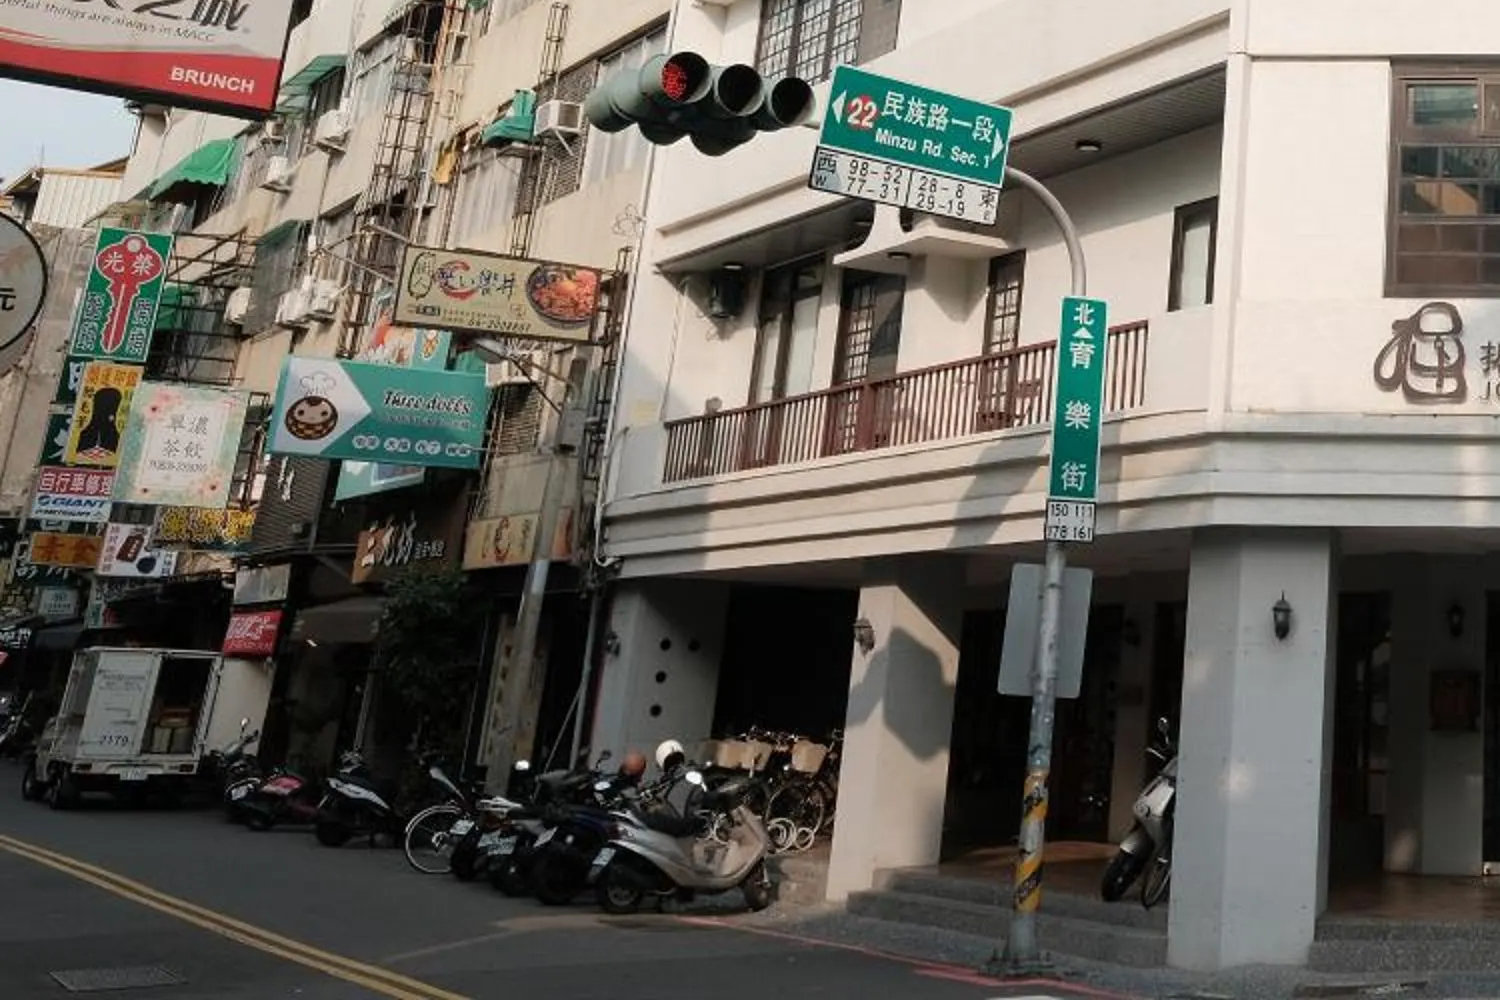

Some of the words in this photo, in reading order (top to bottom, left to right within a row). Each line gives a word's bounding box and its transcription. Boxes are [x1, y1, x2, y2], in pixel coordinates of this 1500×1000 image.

[171, 66, 255, 94] BRUNCH
[847, 97, 878, 129] 22
[881, 91, 996, 143] 民族路一段
[875, 127, 917, 151] Minzu
[922, 139, 945, 158] Rd.
[951, 145, 980, 167] Sec.
[983, 155, 990, 169] 1
[818, 152, 837, 174] 西
[850, 159, 903, 185] 98-52
[847, 176, 900, 200] 77-31
[917, 175, 966, 199] 28-8
[979, 189, 997, 209] 東
[916, 193, 966, 217] 29-19
[103, 251, 155, 276] 光榮
[1073, 303, 1095, 326] 北
[1060, 341, 1096, 492] 育樂街
[53, 496, 106, 508] GIANT
[1051, 503, 1068, 517] 150
[1073, 525, 1092, 539] 161
